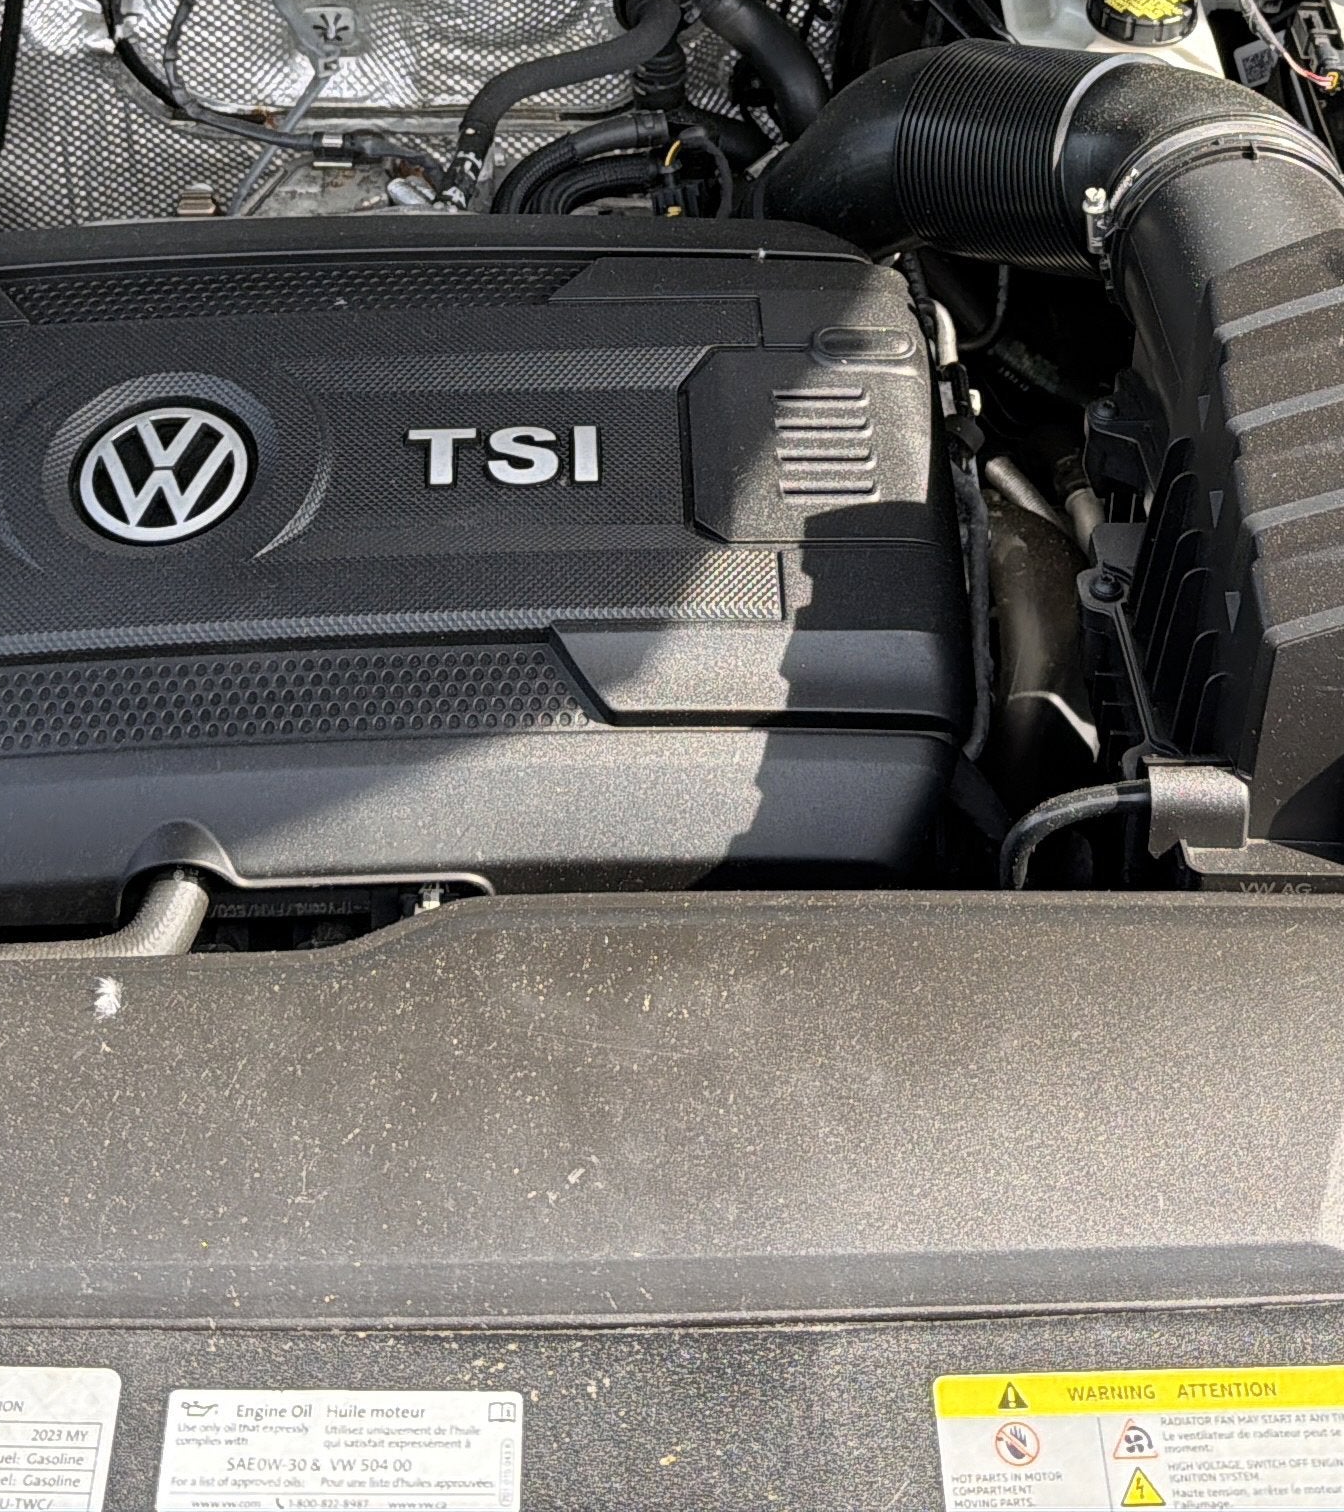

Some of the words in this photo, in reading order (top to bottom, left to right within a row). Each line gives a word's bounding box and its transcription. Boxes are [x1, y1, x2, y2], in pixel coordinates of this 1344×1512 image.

[406, 424, 600, 487] TSI
[78, 405, 249, 543] VW
[1239, 882, 1276, 894] VW
[1281, 883, 1312, 895] AG
[1067, 1384, 1156, 1402] WARNING
[1176, 1381, 1278, 1399] ATTENTION
[236, 1404, 287, 1422] Engine
[291, 1404, 312, 1418] Oil
[326, 1405, 366, 1419] Huile
[370, 1406, 426, 1419] moteur
[1161, 1415, 1212, 1426] RADIATOR
[1214, 1415, 1235, 1425] FAN
[1238, 1414, 1258, 1424] MAY
[1261, 1414, 1292, 1424] START
[1309, 1412, 1329, 1422] ANY
[177, 1422, 197, 1433] Use
[199, 1423, 220, 1434] only
[223, 1423, 236, 1433] oil
[238, 1423, 260, 1433] that
[262, 1423, 310, 1435] expressly
[366, 1425, 432, 1438] uniquement
[434, 1425, 447, 1435] de
[1162, 1431, 1175, 1442] Le
[1178, 1430, 1234, 1441] ventilateur
[1237, 1429, 1251, 1439] de
[1253, 1429, 1301, 1439] radiateur
[1303, 1428, 1328, 1439] peut
[31, 1429, 62, 1442] 2023
[65, 1430, 89, 1442] MY
[175, 1436, 222, 1448] complies
[224, 1436, 249, 1446] with
[323, 1439, 341, 1450] qui
[344, 1438, 385, 1448] satisfait
[26, 1453, 84, 1466] Gasoline
[310, 1459, 322, 1472] &
[330, 1458, 357, 1472] VW
[360, 1458, 388, 1472] 504
[392, 1458, 413, 1472] 00
[1167, 1461, 1193, 1471] HIGH
[1246, 1459, 1287, 1470] SWITCH
[1288, 1458, 1308, 1468] OFF
[22, 1475, 81, 1487] Gasoline
[170, 1476, 188, 1486] For
[199, 1476, 215, 1486] list
[217, 1476, 229, 1486] of
[230, 1476, 281, 1489] approved
[320, 1476, 344, 1487] Pour
[346, 1478, 366, 1488] une
[952, 1474, 974, 1484] HOT
[976, 1473, 1008, 1483] PARTS
[1024, 1471, 1063, 1482] MOTOR
[1169, 1473, 1216, 1483] IGNITION
[1172, 1487, 1205, 1498] Haute
[1304, 1484, 1342, 1495] moteur
[954, 1498, 998, 1508] MOVING
